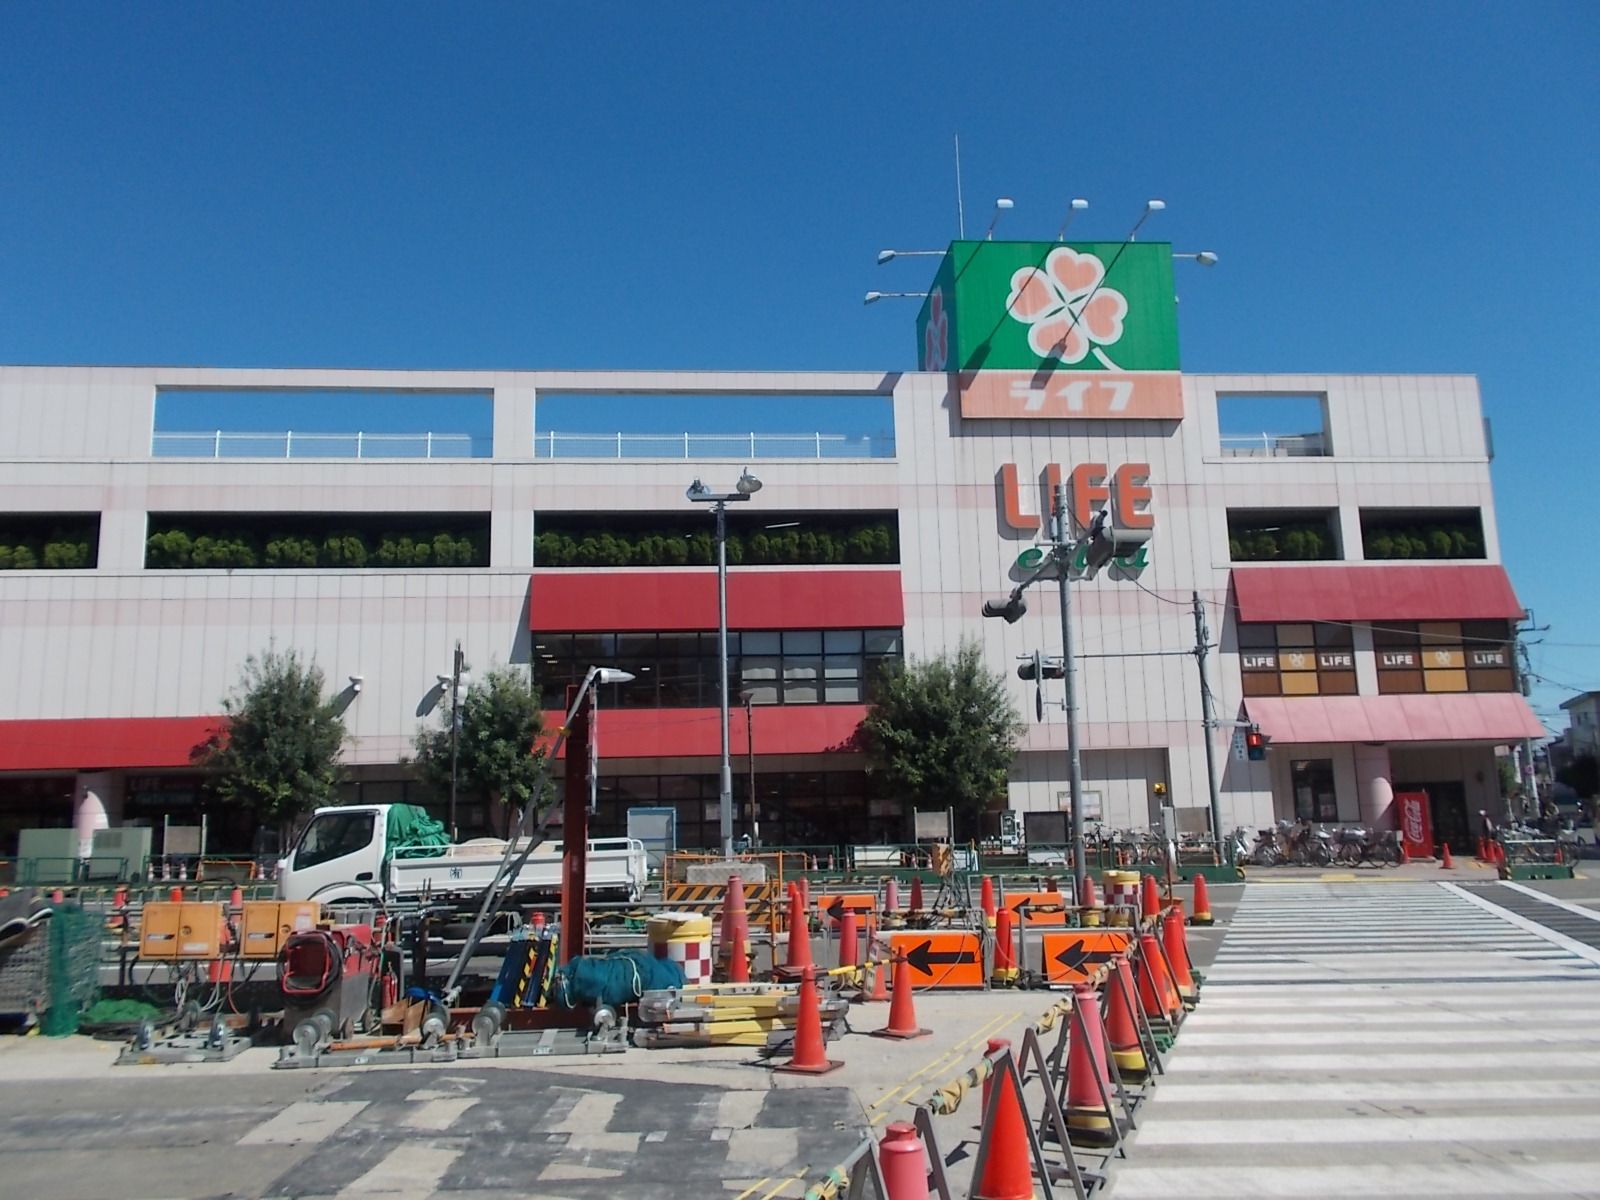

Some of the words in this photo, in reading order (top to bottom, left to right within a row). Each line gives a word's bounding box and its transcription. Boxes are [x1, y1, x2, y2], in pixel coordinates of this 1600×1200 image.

[1009, 380, 1135, 411] ライフ
[1243, 657, 1275, 667] LIFE
[1320, 656, 1351, 666] LIFE
[1383, 655, 1413, 665] LIFE
[1474, 654, 1504, 664] LIFE
